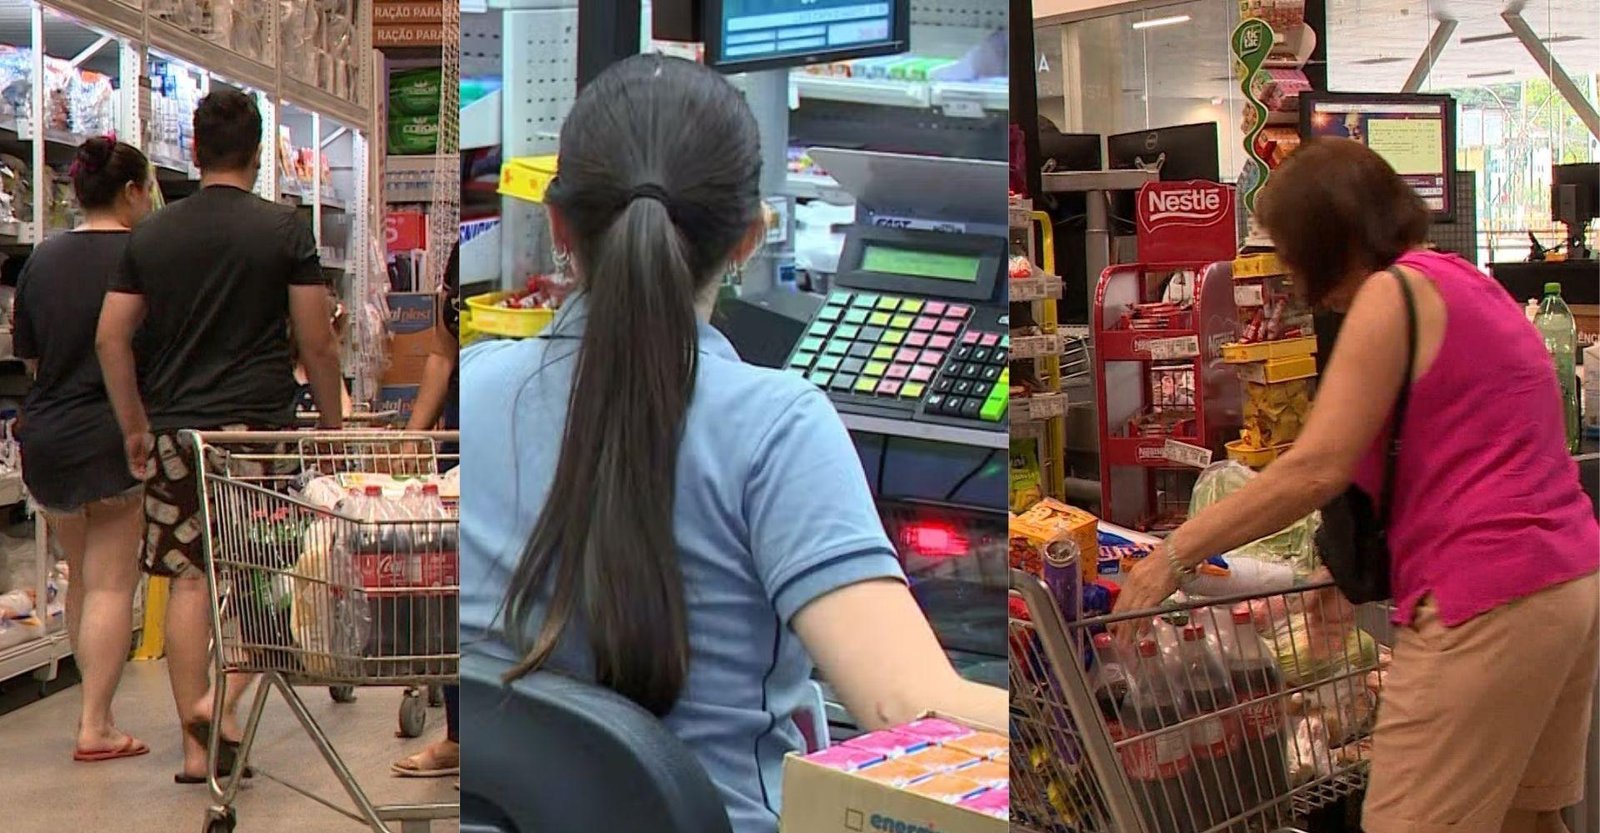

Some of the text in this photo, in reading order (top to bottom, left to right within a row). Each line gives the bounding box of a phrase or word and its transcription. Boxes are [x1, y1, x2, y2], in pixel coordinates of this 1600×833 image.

[374, 6, 410, 20] RAÇÃO
[413, 7, 442, 18] PARA
[377, 28, 413, 42] RAÇÃO
[1148, 188, 1220, 212] Nestlé
